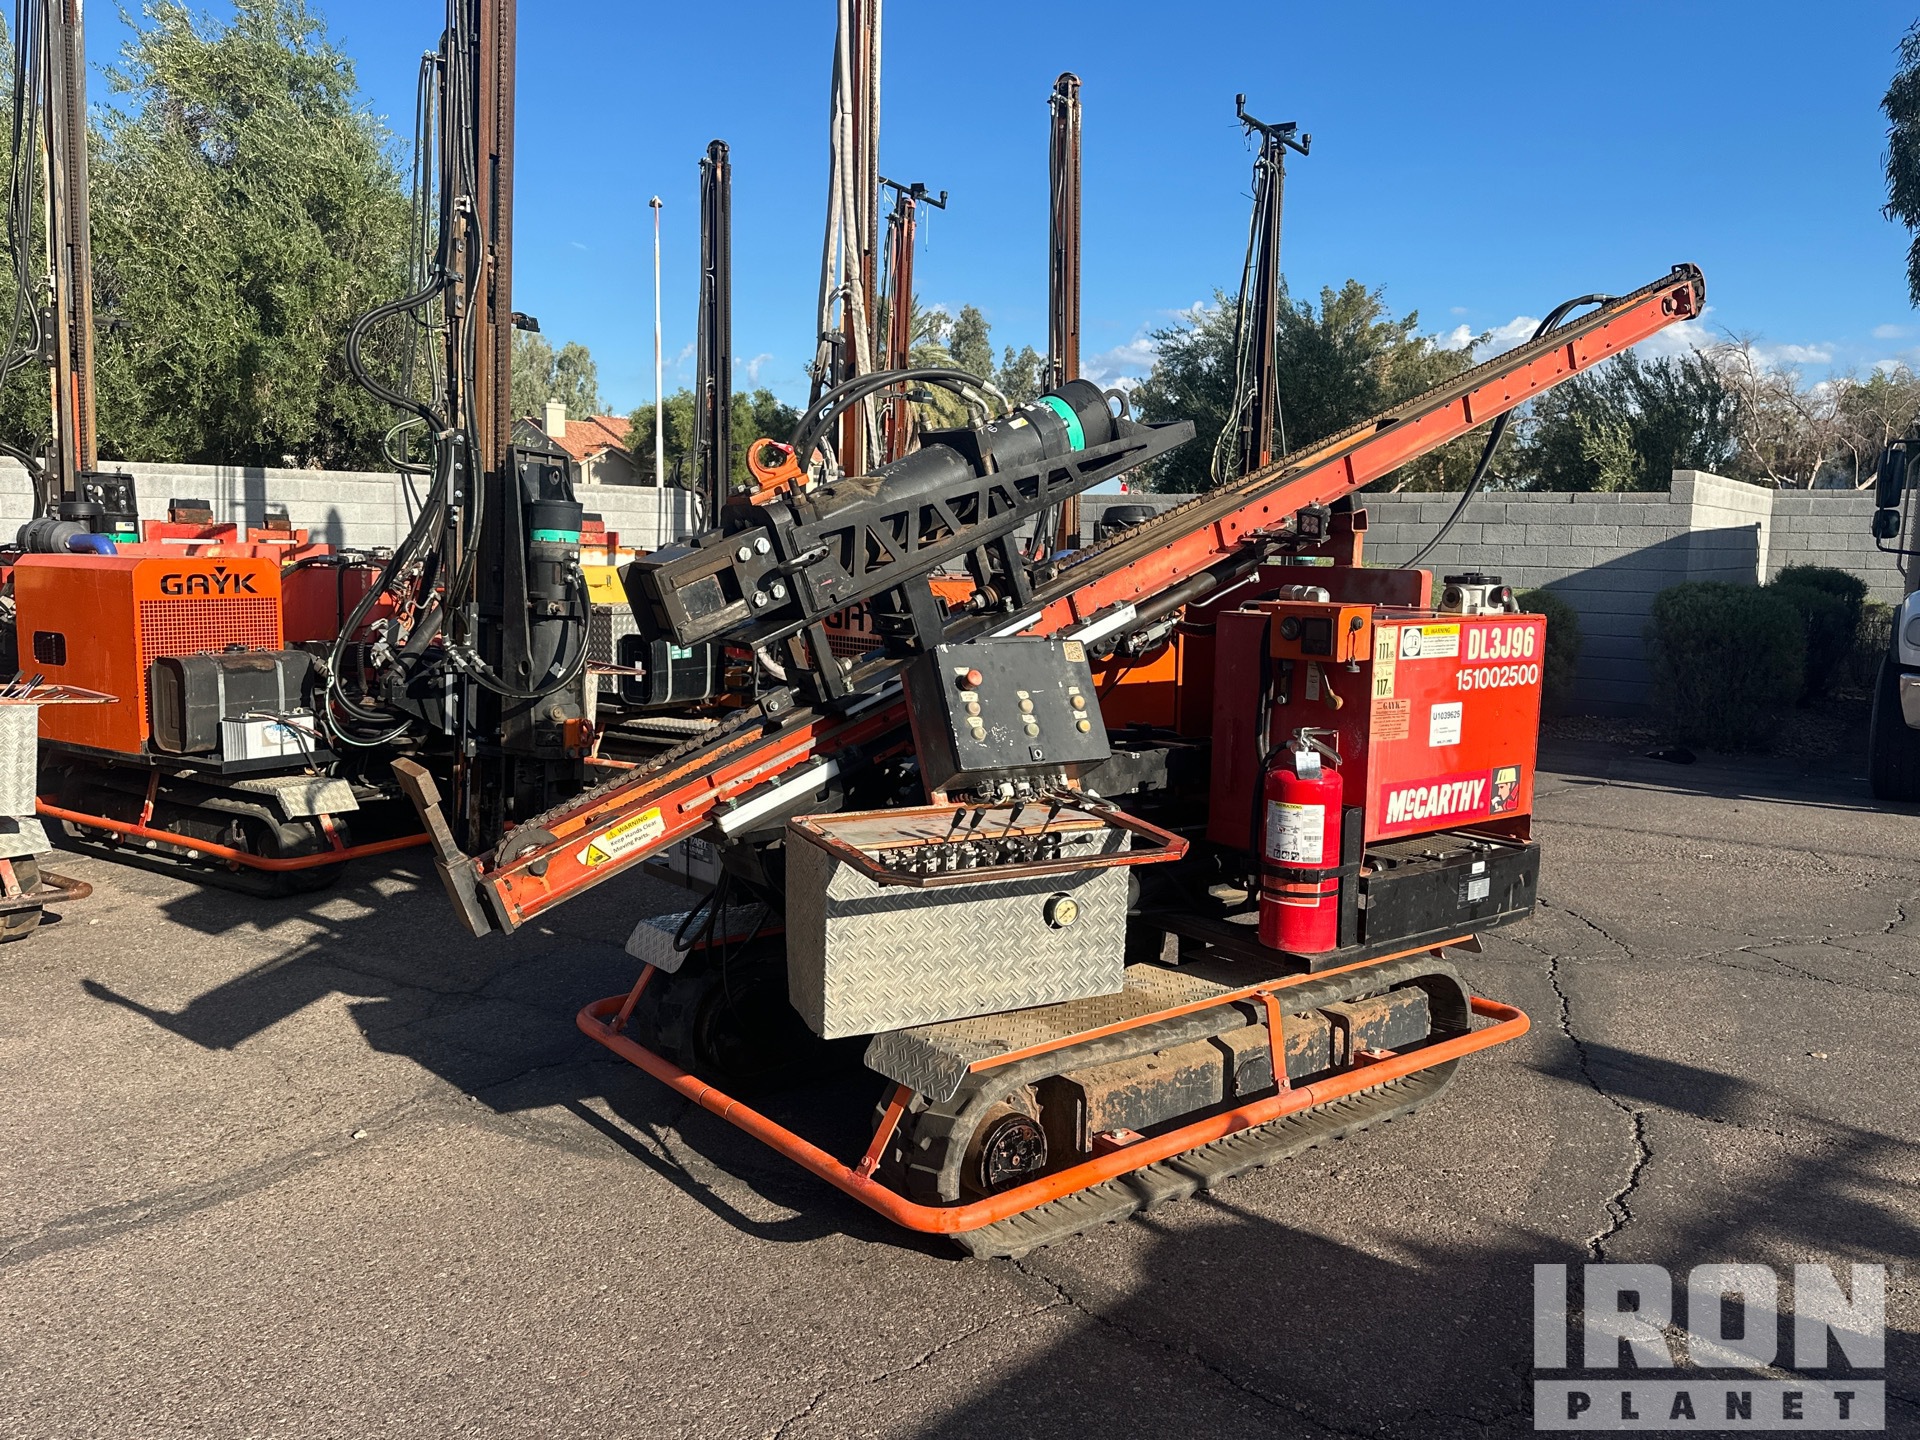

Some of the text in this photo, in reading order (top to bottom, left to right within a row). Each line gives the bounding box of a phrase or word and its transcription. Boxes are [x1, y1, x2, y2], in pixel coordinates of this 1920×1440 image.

[160, 572, 259, 595] GAYK
[1431, 627, 1451, 635] WARNING
[1467, 626, 1535, 660] DL3J96
[1376, 678, 1389, 696] 117
[1455, 663, 1539, 691] 151002500
[610, 820, 657, 847] Keep Hands Clear
[616, 815, 649, 834] WARNING
[612, 833, 650, 854] Moving Parts.
